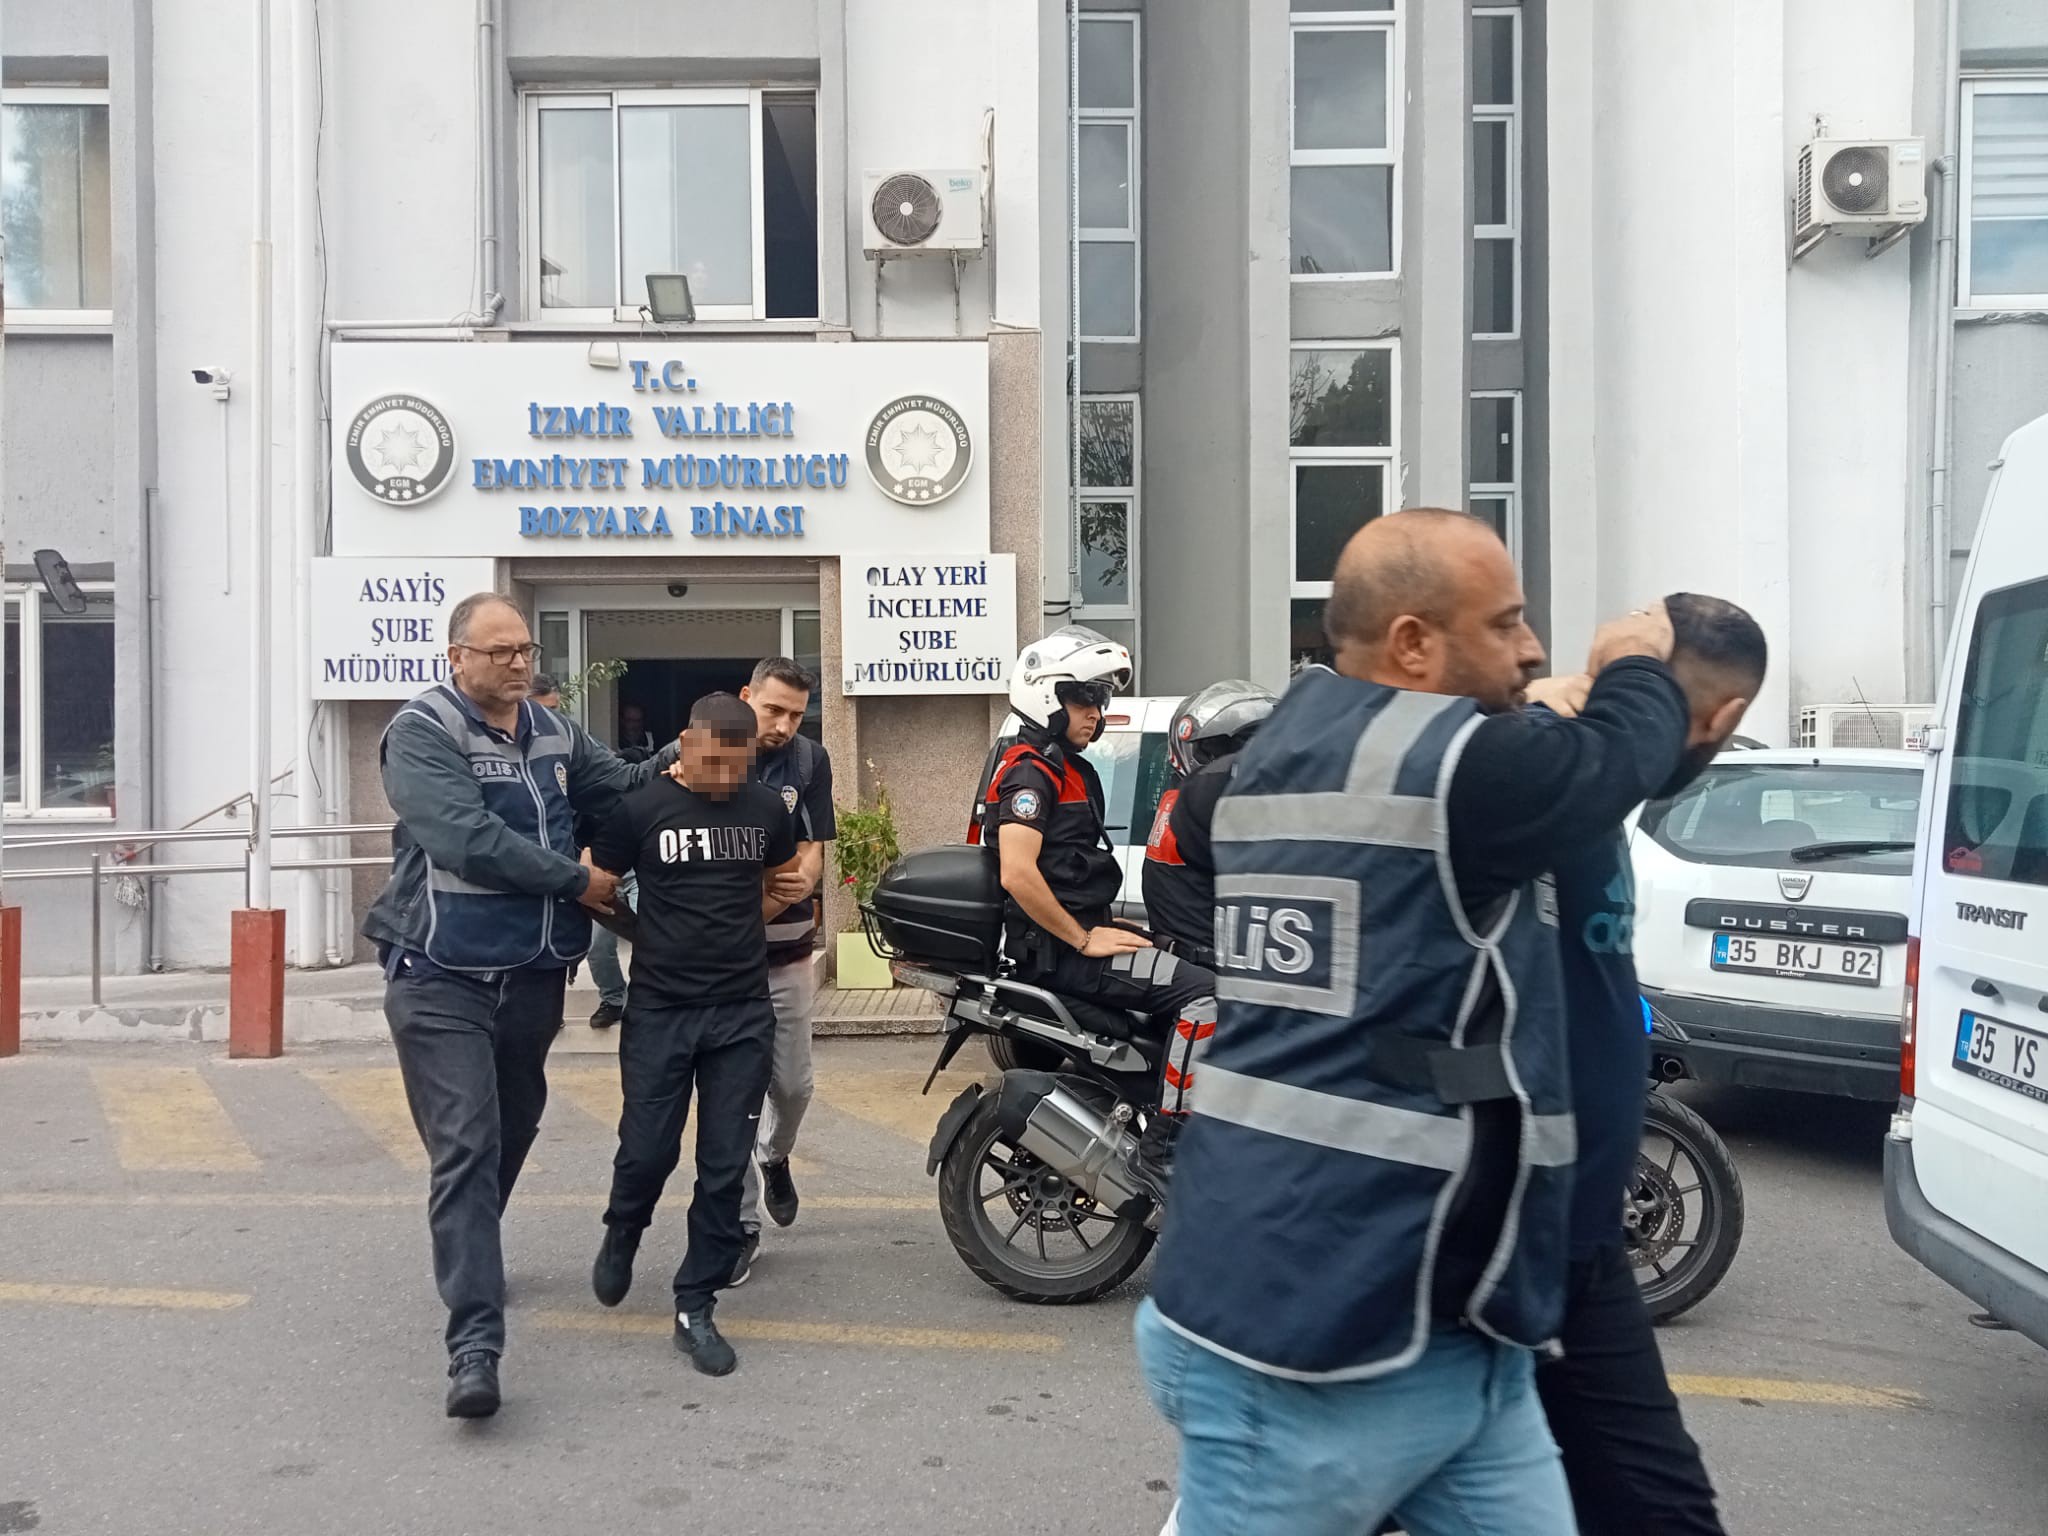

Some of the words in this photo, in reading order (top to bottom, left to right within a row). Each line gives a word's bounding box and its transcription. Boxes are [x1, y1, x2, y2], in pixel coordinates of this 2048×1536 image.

[629, 360, 697, 390] T.C.
[528, 402, 634, 438] İZMİR
[652, 402, 794, 438] VALİLİĞİ
[389, 479, 411, 488] EGM
[472, 454, 629, 489] EMNİYET
[641, 453, 850, 489] MÜDÜRLÜĞÜ
[518, 506, 673, 536] BOZYAKA
[690, 501, 805, 536] BİNASI
[359, 572, 445, 606] ASAYİŞ
[866, 567, 926, 587] OLAY
[934, 561, 988, 586] YERİ
[868, 594, 988, 619] İNCELEME
[371, 618, 434, 646] ŞUBE
[899, 630, 957, 653] ŞUBE
[323, 653, 453, 683] MÜDÜRLÜ
[854, 657, 1002, 683] MÜDÜRLÜĞÜ
[658, 826, 766, 864] OFFLINE
[1720, 916, 1865, 937] DUSTER
[1955, 901, 2028, 931] TRANSIT
[1729, 939, 1757, 963] 35
[1776, 943, 1822, 970] BKJ
[1842, 950, 1873, 976] 82
[1970, 1023, 1997, 1064] 35
[2013, 1034, 2039, 1079] YS
